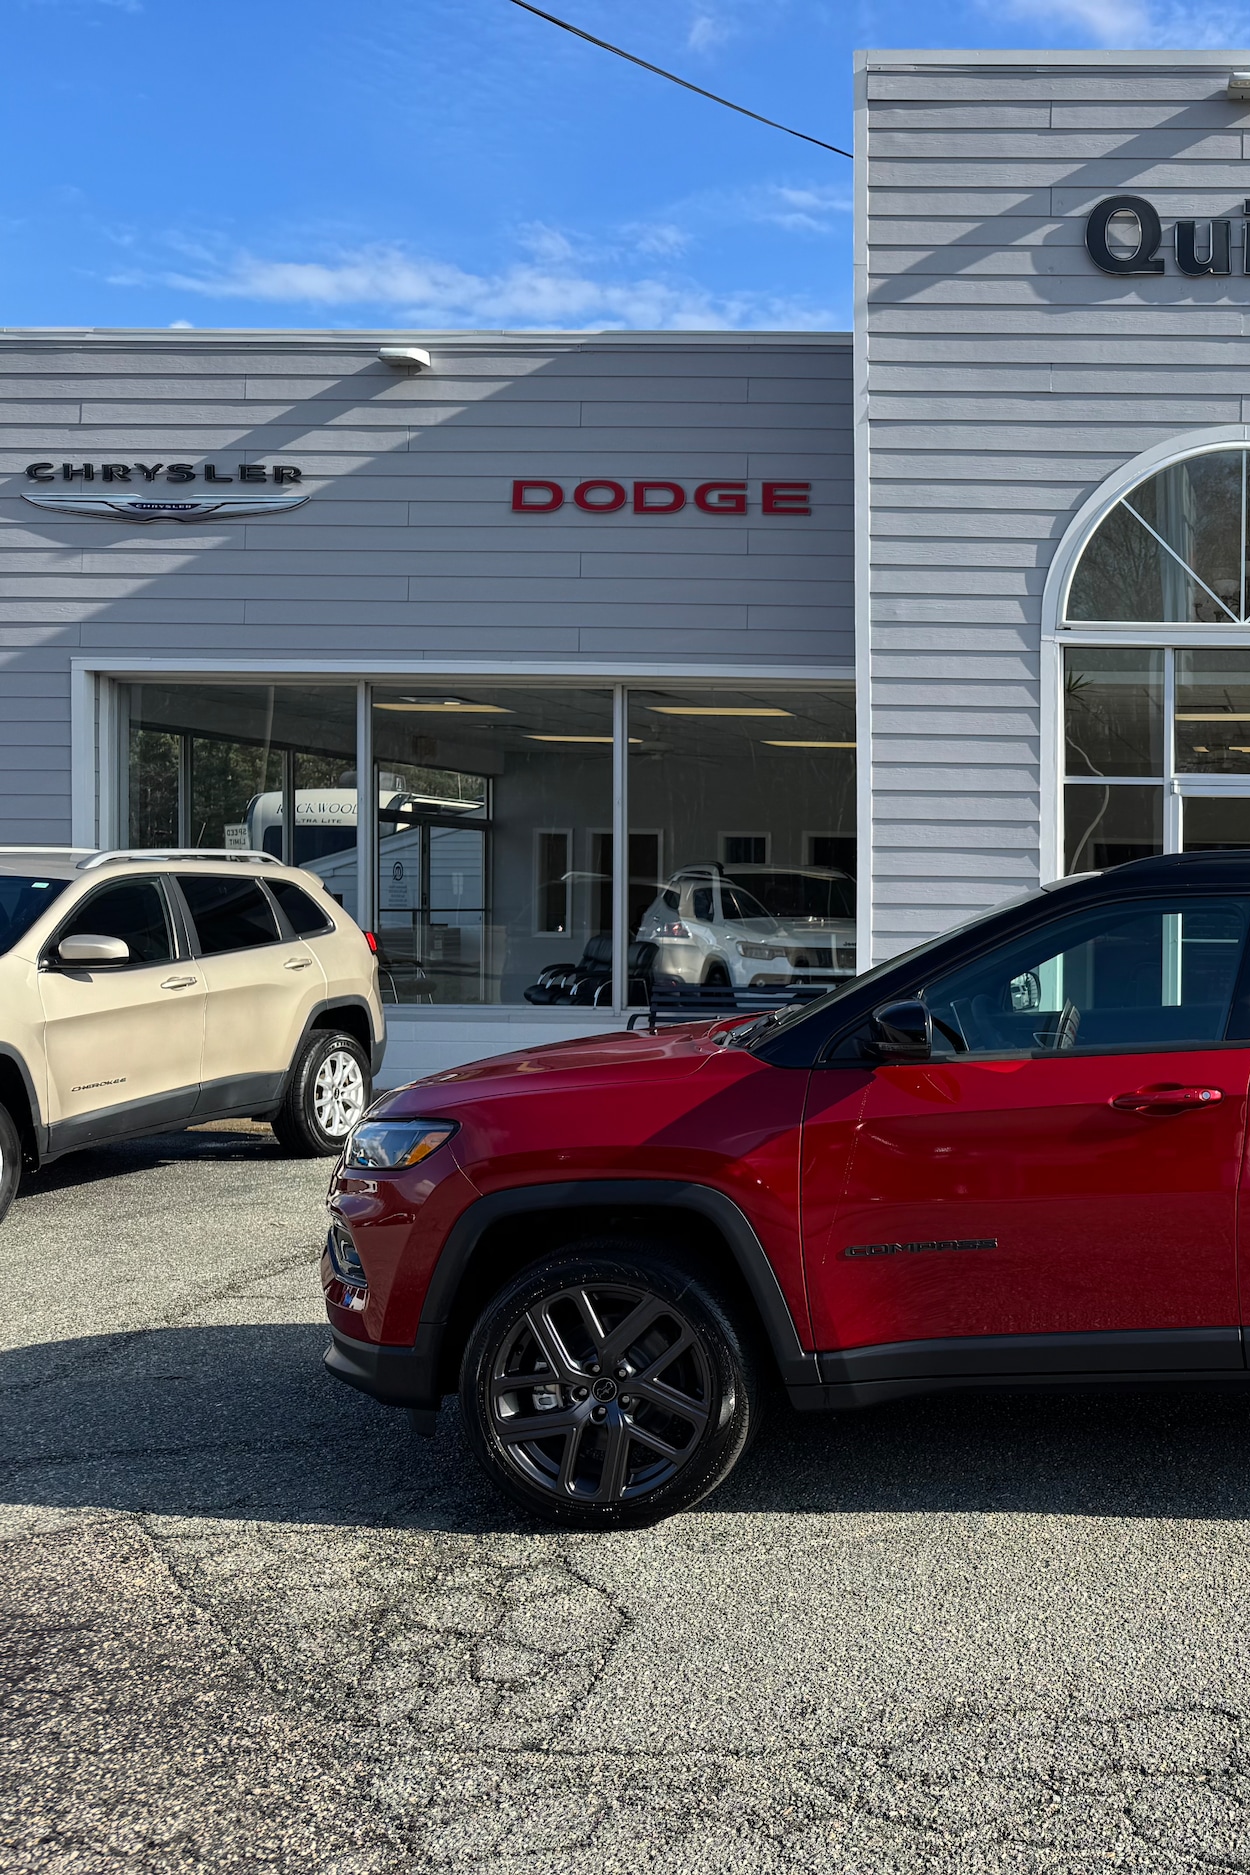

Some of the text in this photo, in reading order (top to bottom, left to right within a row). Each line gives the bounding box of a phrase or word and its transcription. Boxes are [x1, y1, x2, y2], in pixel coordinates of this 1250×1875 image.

[24, 462, 304, 484] CHRYSLER
[511, 479, 811, 515] DODGE
[71, 1077, 127, 1092] CHEROKEE
[844, 1238, 998, 1257] COMPASS
